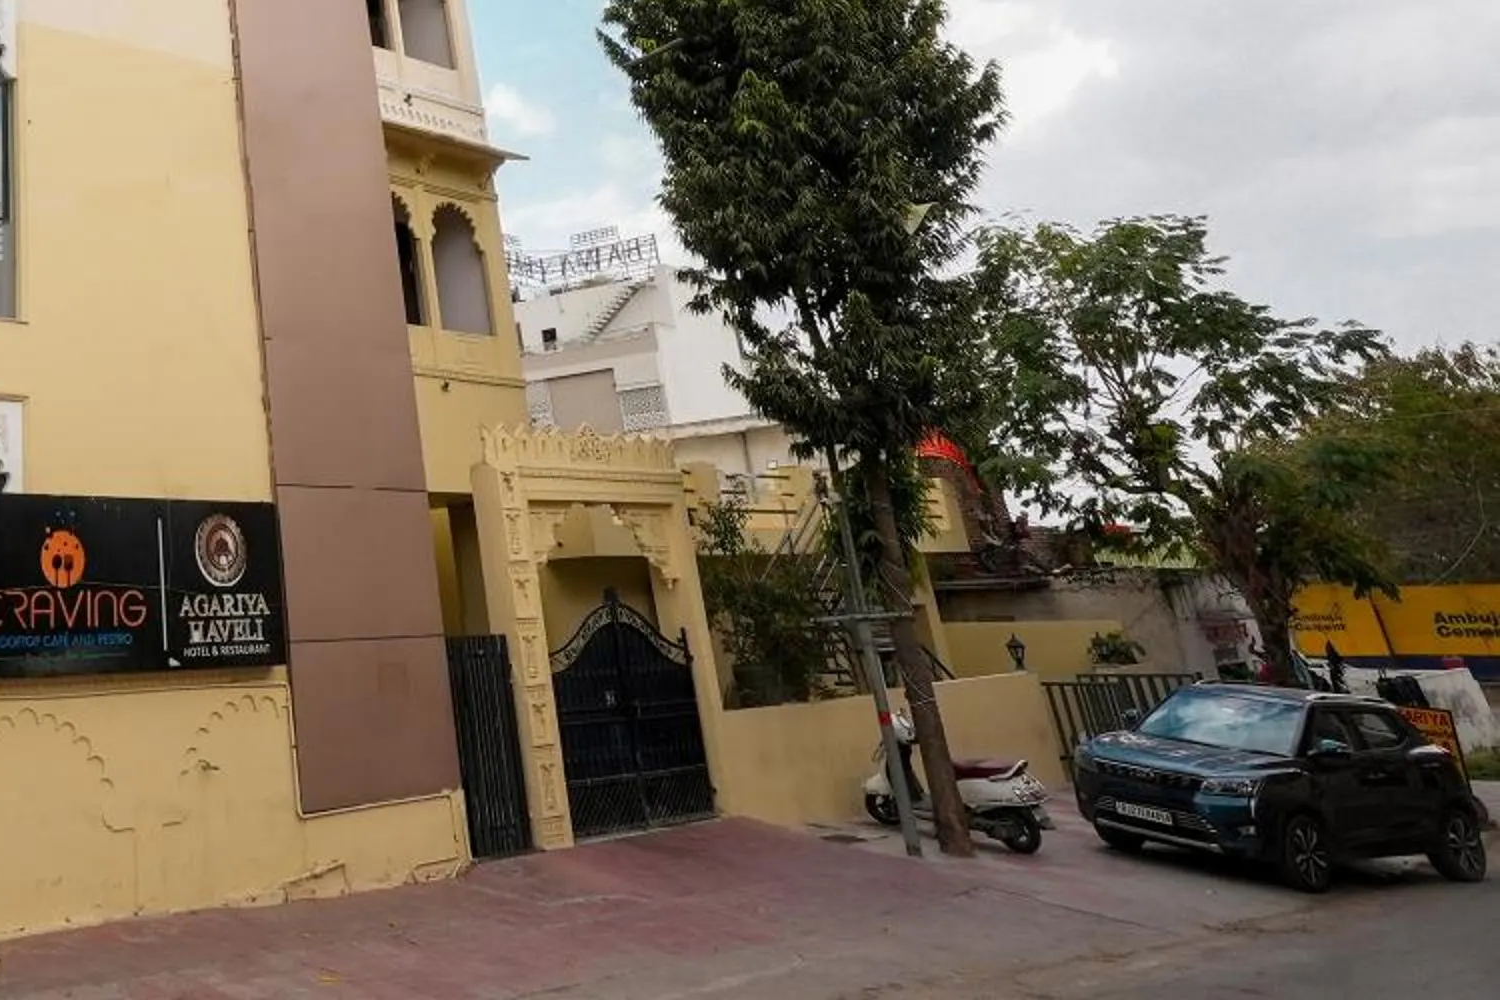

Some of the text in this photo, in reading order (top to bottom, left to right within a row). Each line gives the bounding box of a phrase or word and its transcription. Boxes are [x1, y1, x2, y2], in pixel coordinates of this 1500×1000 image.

[180, 592, 271, 617] AGARIYA
[1434, 612, 1500, 627] Ambuj
[188, 617, 265, 644] HAVELI
[183, 643, 271, 657] HOTEL & RESTAURANT
